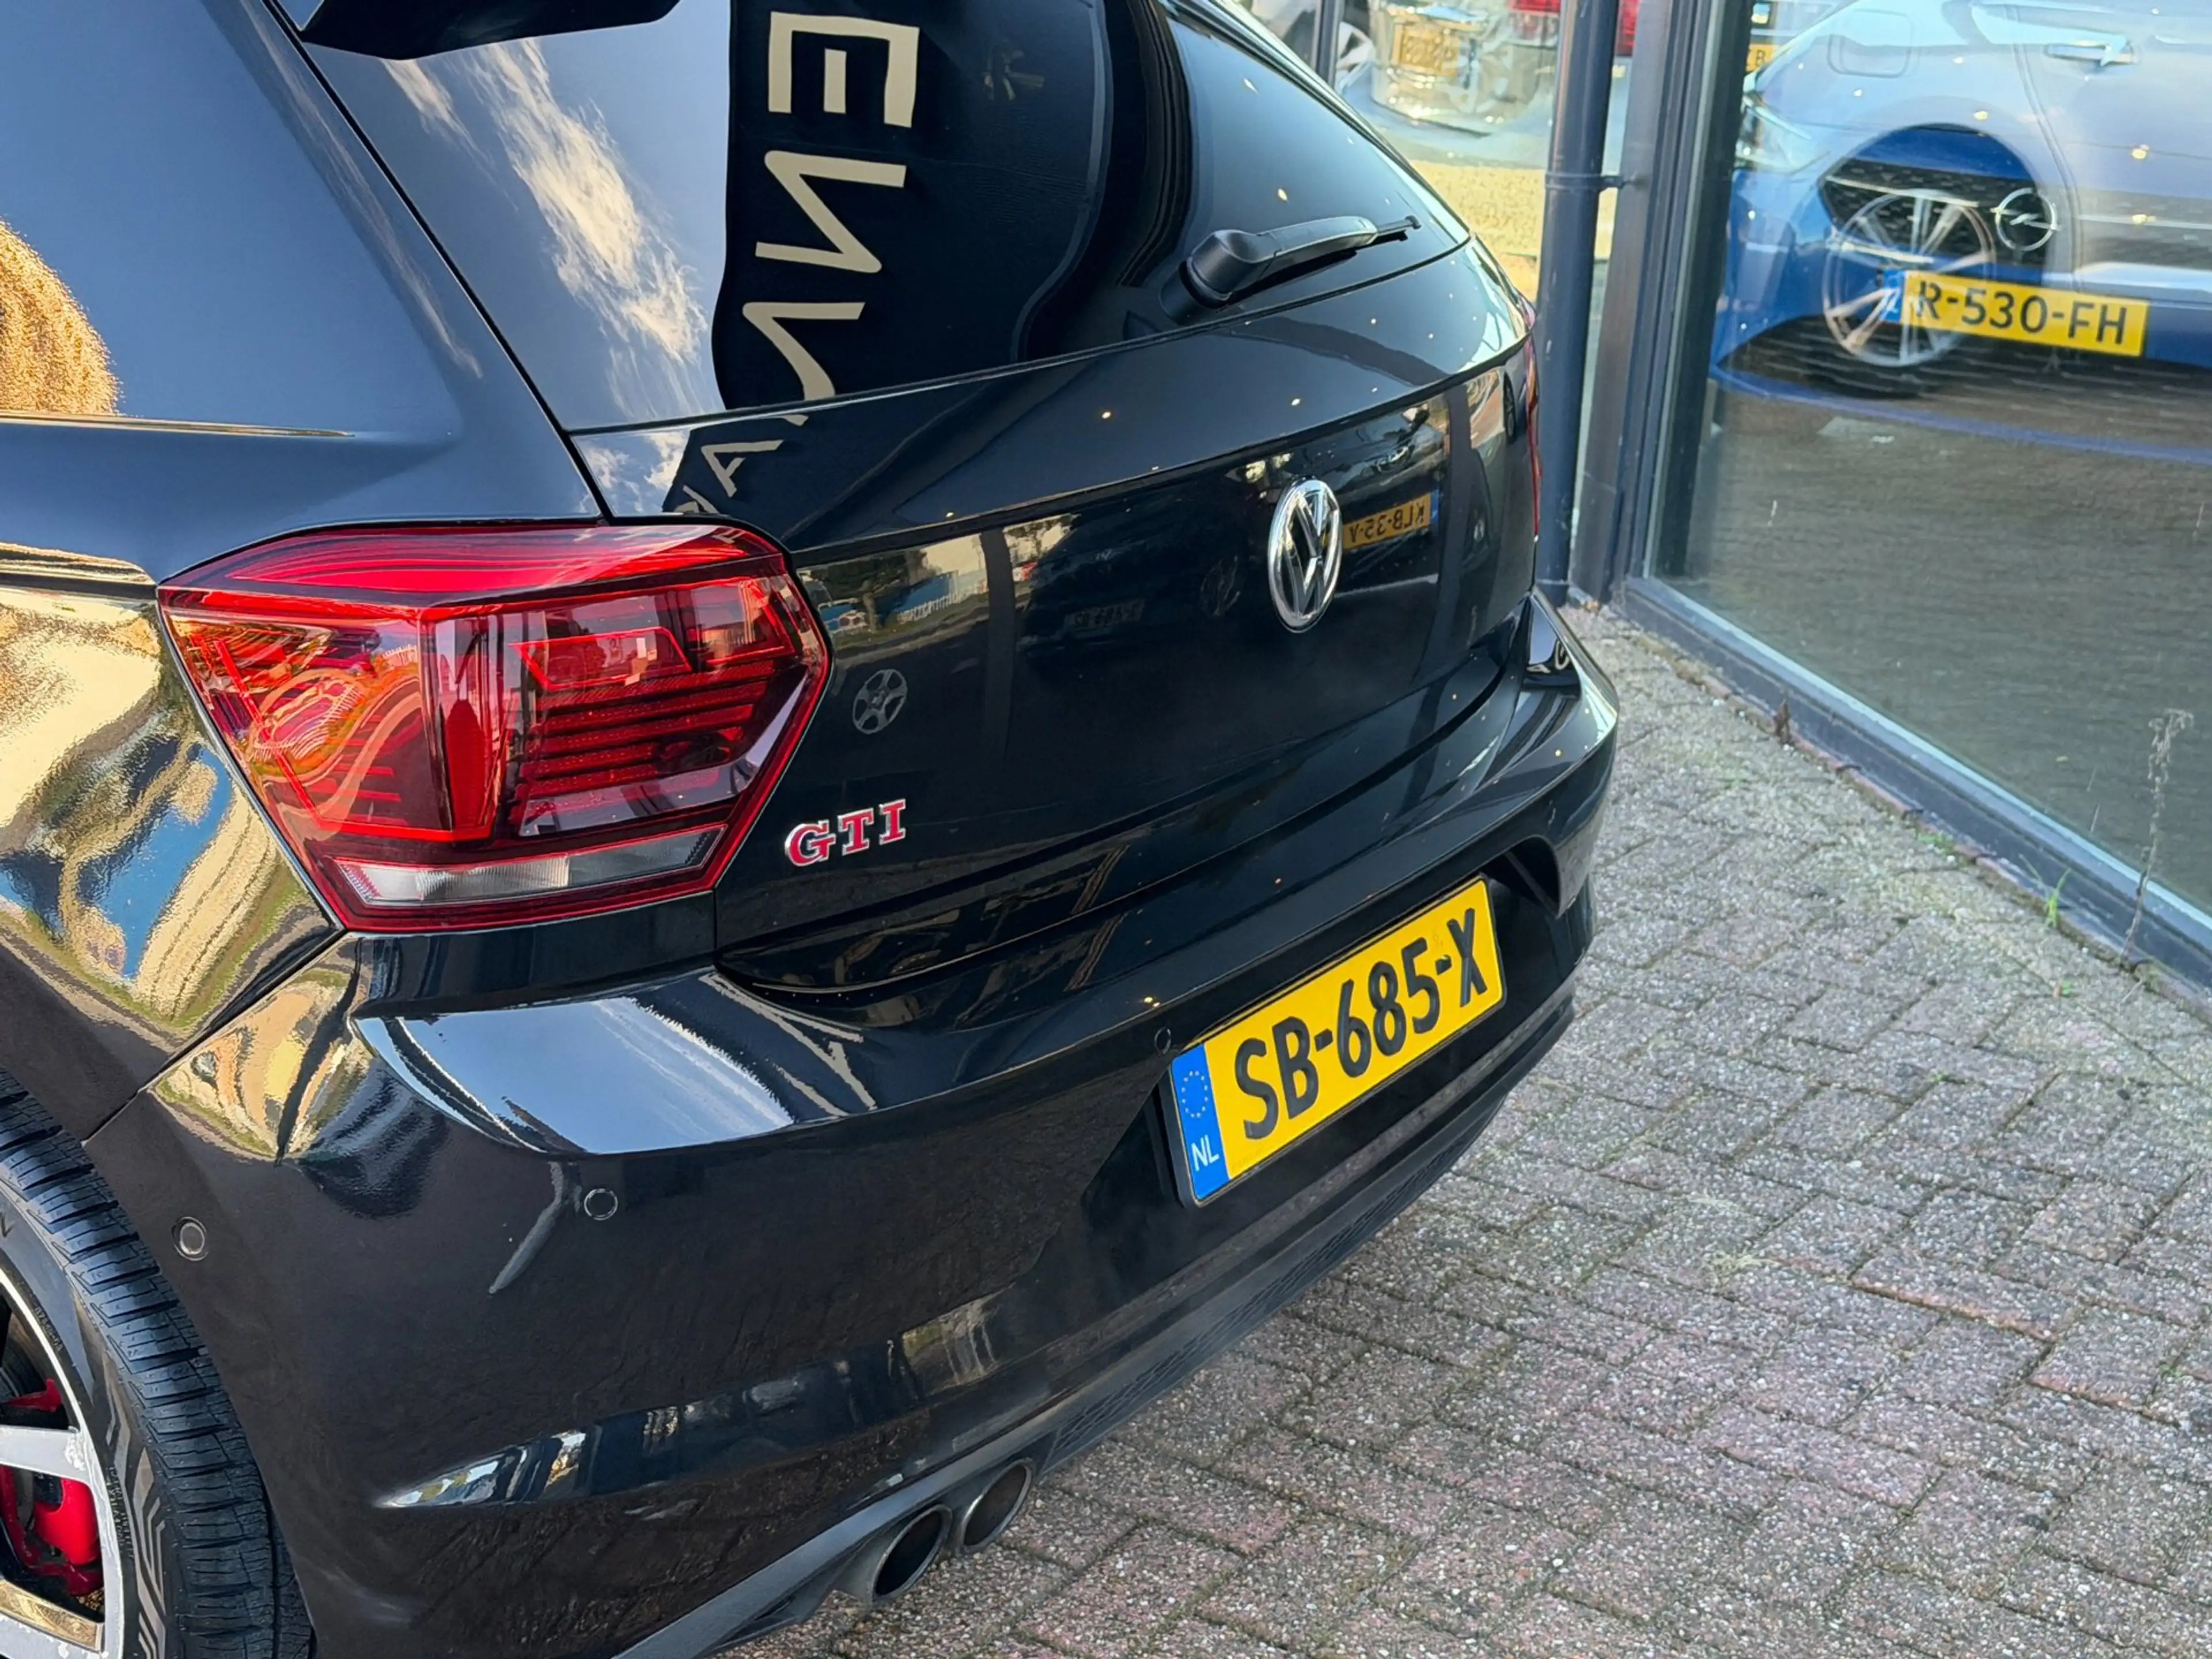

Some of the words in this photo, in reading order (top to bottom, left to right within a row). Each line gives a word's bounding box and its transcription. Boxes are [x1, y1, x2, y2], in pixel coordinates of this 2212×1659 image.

[1915, 280, 2127, 345] R-530-FH
[784, 798, 907, 867] GTI
[1234, 907, 1488, 1141] SB-685-X
[1191, 1134, 1220, 1172] NL
